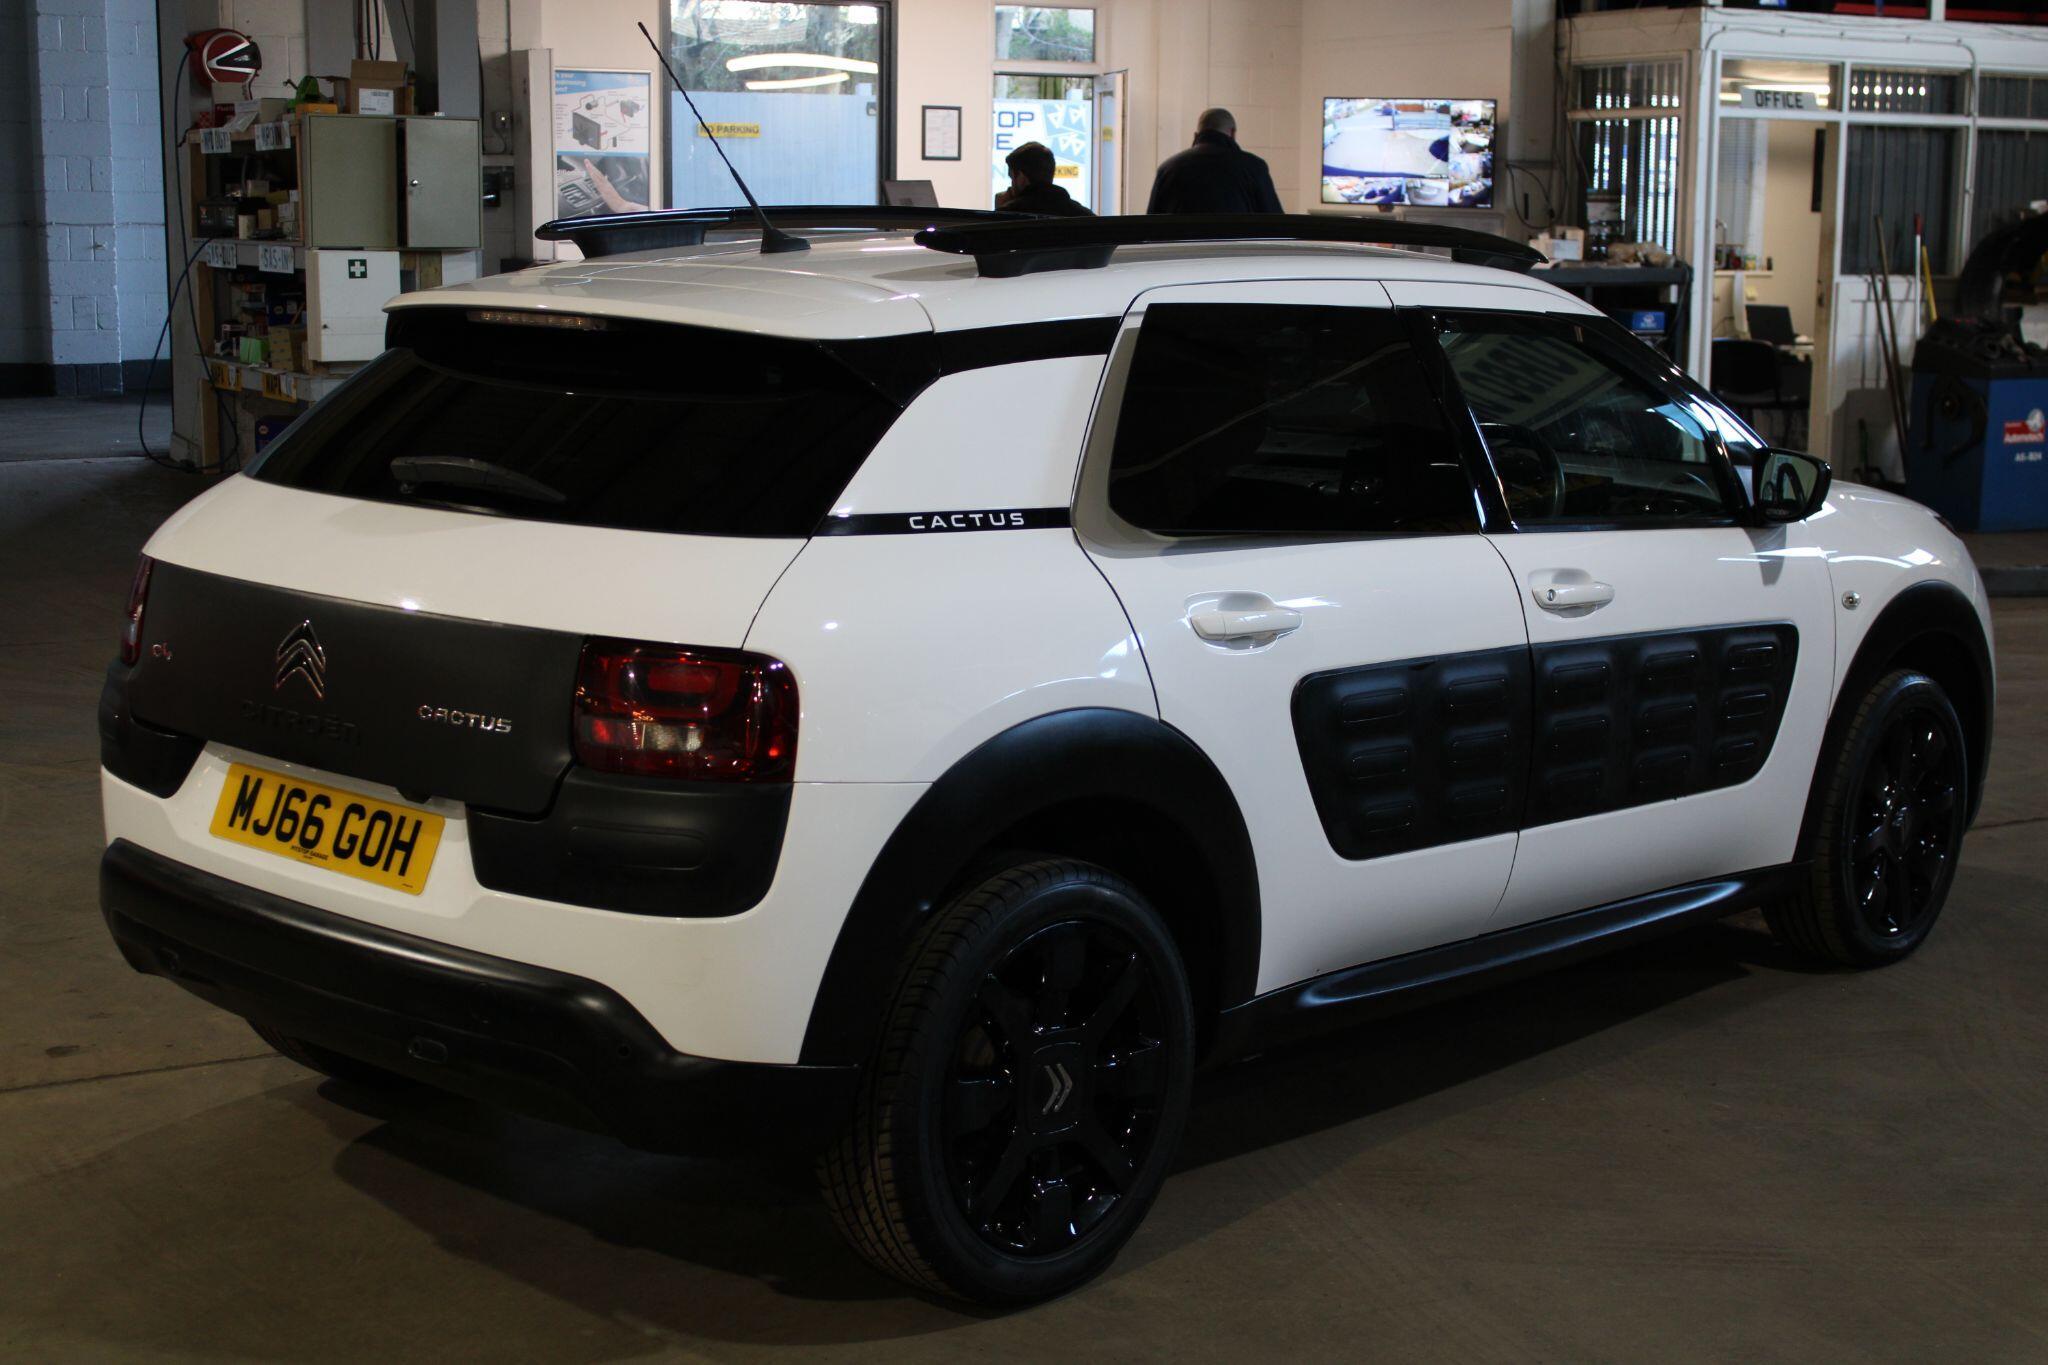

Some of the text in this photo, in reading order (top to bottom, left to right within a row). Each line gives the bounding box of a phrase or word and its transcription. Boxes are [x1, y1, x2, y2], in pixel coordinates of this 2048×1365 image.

[1755, 89, 1803, 109] OFFICE
[993, 110, 1034, 128] OP
[716, 125, 760, 135] PARKING
[908, 512, 1026, 529] CACTUS
[417, 703, 513, 733] CACTUS
[228, 774, 423, 877] MJ66 GOH
